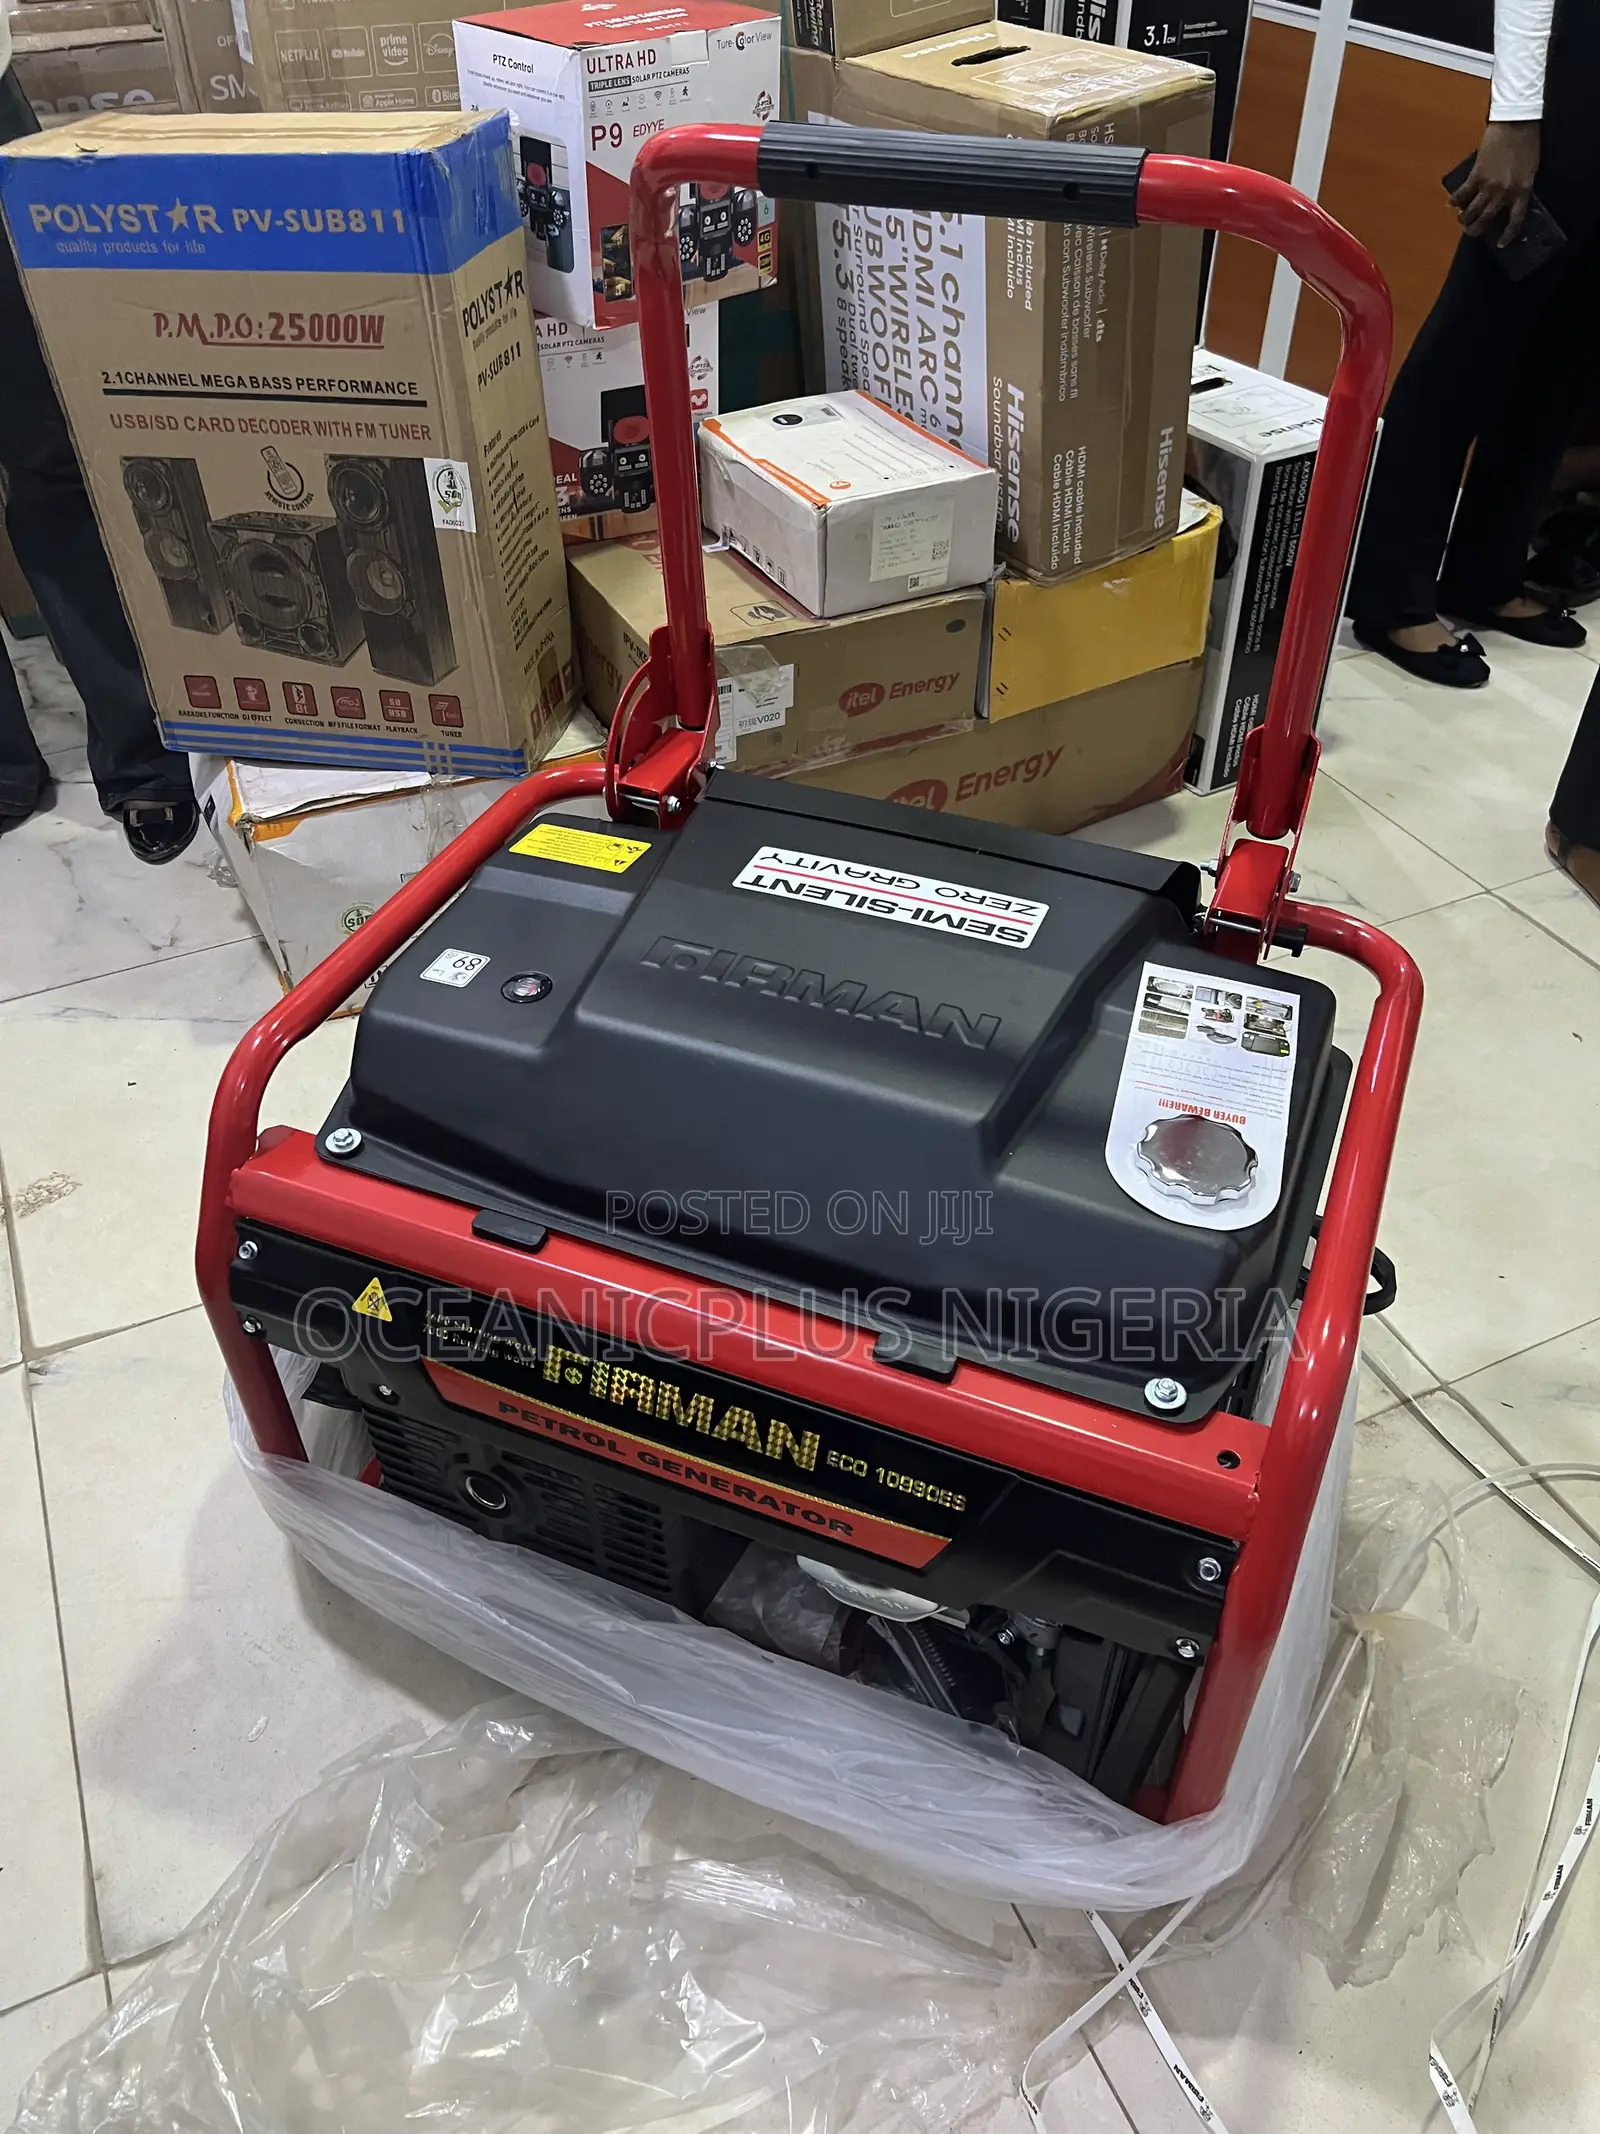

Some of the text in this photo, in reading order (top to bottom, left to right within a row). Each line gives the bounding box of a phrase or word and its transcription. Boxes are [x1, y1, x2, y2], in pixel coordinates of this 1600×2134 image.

[380, 34, 408, 47] prime
[382, 46, 409, 57] video
[755, 32, 772, 43] View
[281, 48, 320, 64] NETFLIX
[493, 54, 534, 74] PTZ Control
[587, 49, 657, 74] ULTRA HD
[591, 67, 690, 92] TRIPLE LENS SOLAR PTZ CAMERAS
[591, 119, 665, 151] P9 EDYYE
[232, 207, 405, 235] PV-SUB811
[56, 239, 206, 256] quality products for life
[1016, 239, 1025, 285] inclus
[853, 224, 868, 333] Surround
[1007, 235, 1015, 298] incluido
[1024, 239, 1035, 310] included
[837, 297, 847, 311] 8
[1061, 265, 1072, 329] Subwoofer
[1083, 276, 1094, 339] Subwoofer
[547, 323, 568, 338] HD
[847, 302, 858, 350] Dual
[1069, 248, 1083, 399] Caisson de basses sans fil
[1096, 319, 1106, 343] dts
[541, 336, 605, 350] SOLAR CAMERAS
[917, 316, 938, 405] ARC
[102, 370, 418, 396] 2.1CHANNEL MEGA BASS PERFORMANCE
[109, 412, 431, 442] USB/SD CARD DECODER WITH FM TUNER
[992, 376, 1004, 470] Soundbar
[1006, 383, 1025, 543] Hisense
[1154, 426, 1174, 529] Hisense
[555, 473, 578, 485] EAL
[1050, 454, 1062, 570] Cable HDMI incluido
[1074, 446, 1086, 564] HDMI cable included
[1063, 488, 1073, 554] HDMI inclus
[888, 671, 961, 701] Energy
[208, 710, 239, 721] FUNCTION
[284, 717, 325, 727] CONNECTION
[355, 722, 381, 732] FORMAT
[385, 725, 418, 734] PLAYBACK
[757, 711, 781, 724] V020
[440, 730, 462, 738] TUNER
[954, 745, 1066, 802] Energy
[759, 851, 1040, 917] ZERO GRAVITY
[740, 874, 1030, 944] SEMI-SILENT
[640, 935, 1003, 1051] FIRMAN
[1158, 1097, 1247, 1126] BUYER BEWARE!!!
[503, 1350, 536, 1370] watts
[542, 1343, 822, 1473] FIRMAN
[498, 1400, 855, 1539] PETROL GENERATOR
[826, 1449, 869, 1479] ECO
[1173, 2063, 1206, 2103] FIRMAN
